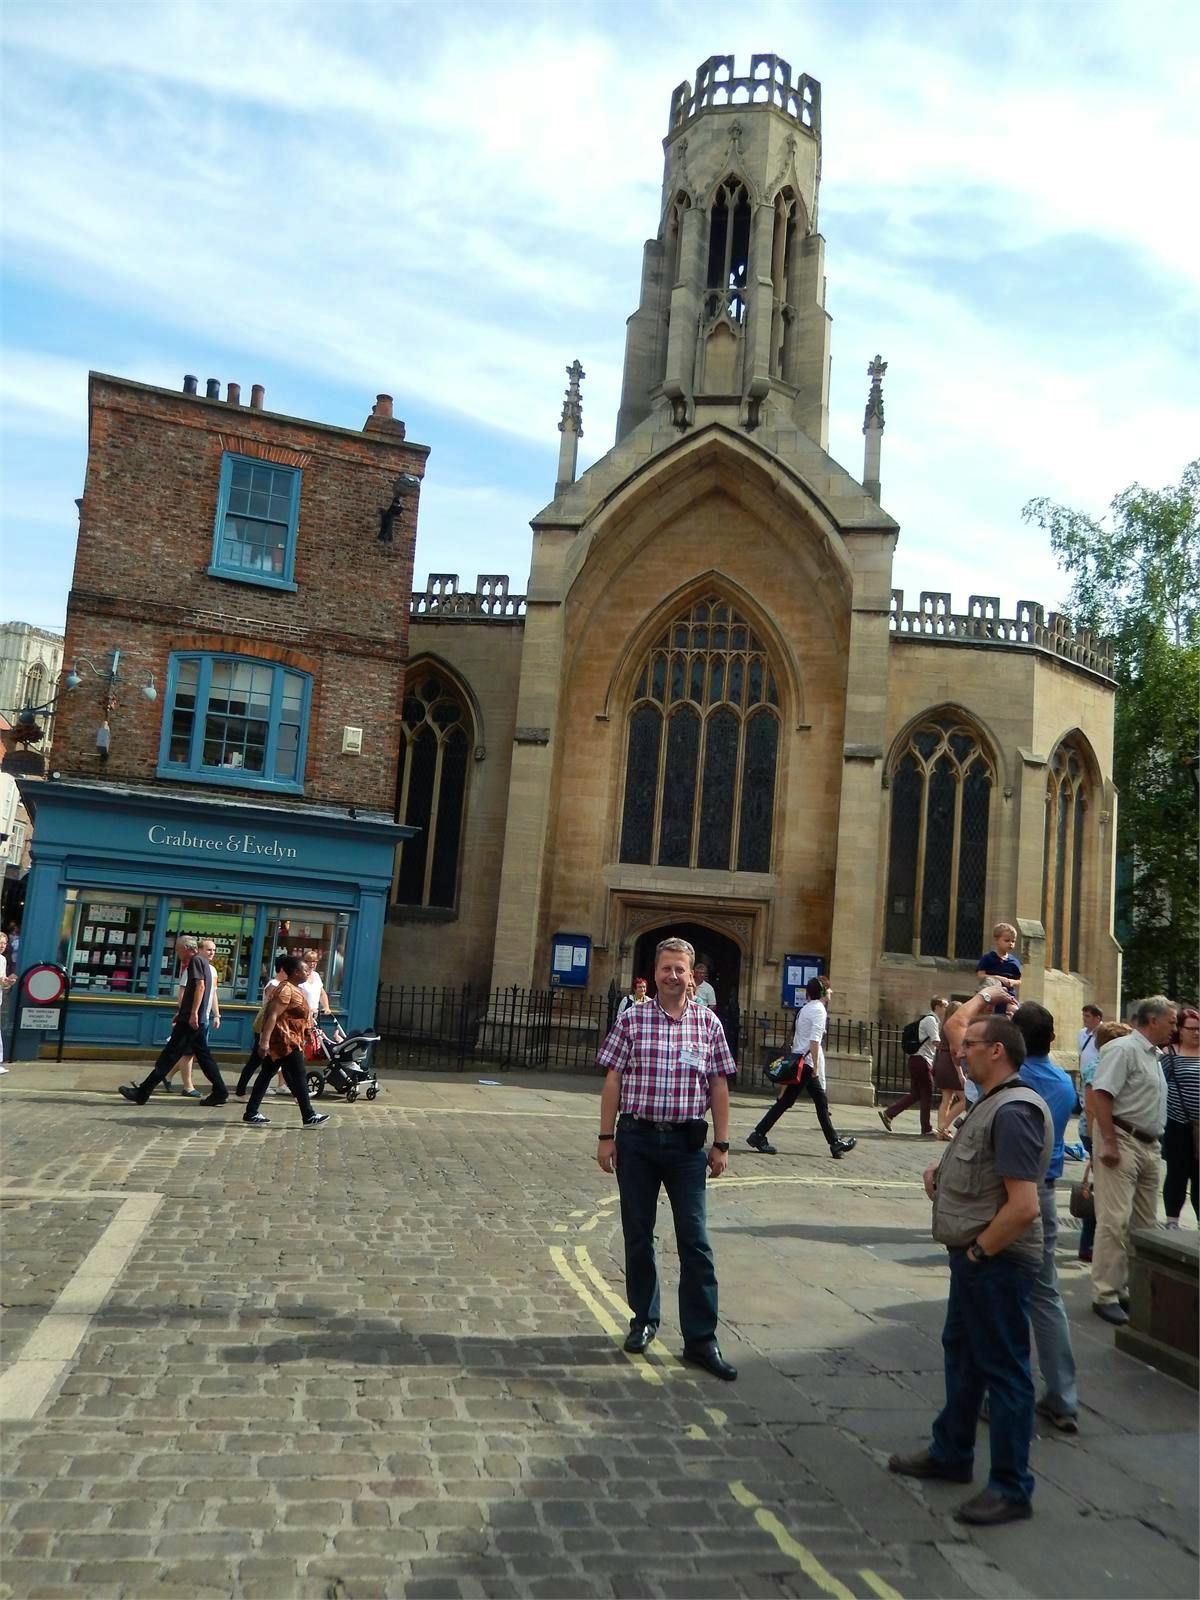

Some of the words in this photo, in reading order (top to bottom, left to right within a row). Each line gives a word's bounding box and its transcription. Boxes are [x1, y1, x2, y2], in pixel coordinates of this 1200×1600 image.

[148, 824, 223, 851] Crabtree
[226, 835, 241, 851] &
[242, 834, 297, 862] Evelyn
